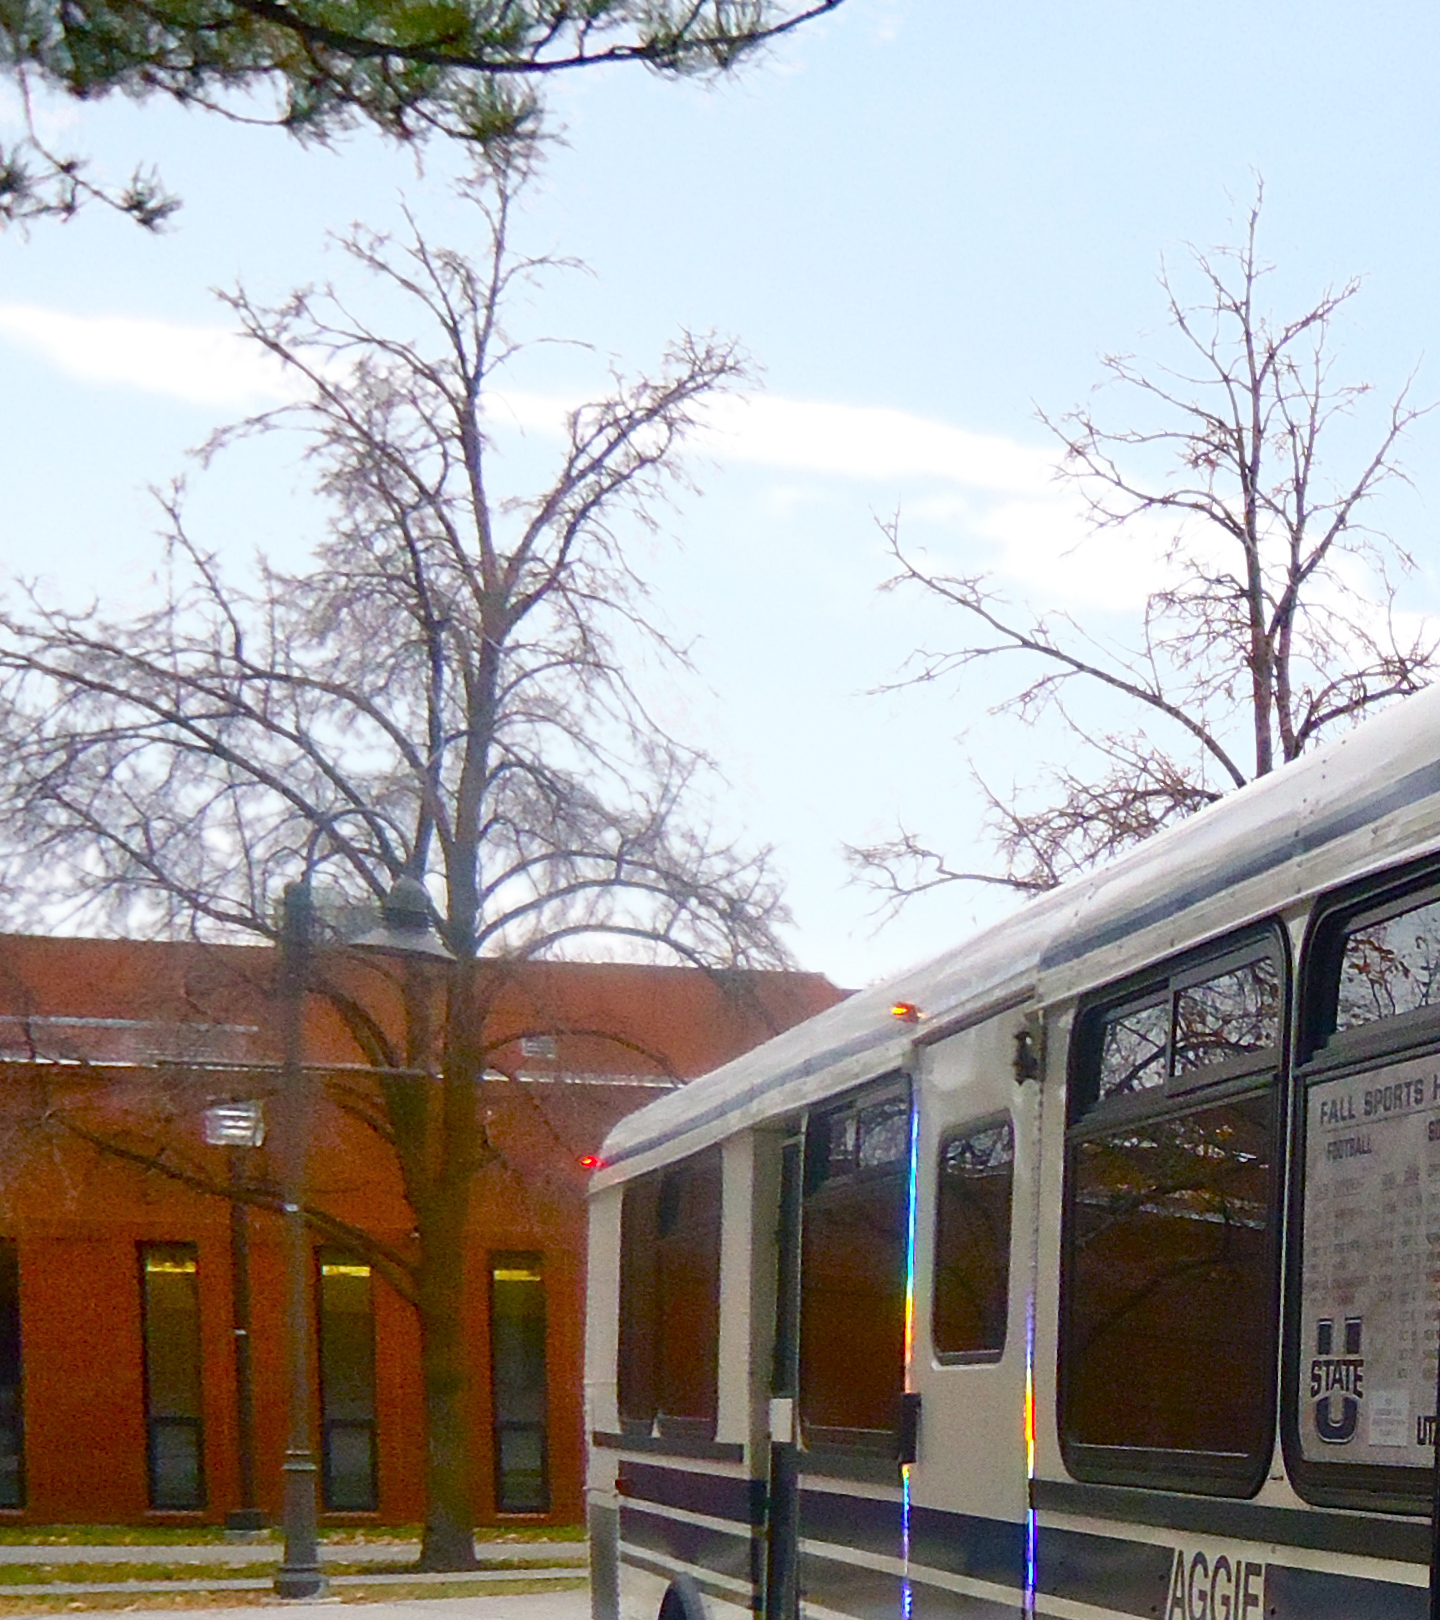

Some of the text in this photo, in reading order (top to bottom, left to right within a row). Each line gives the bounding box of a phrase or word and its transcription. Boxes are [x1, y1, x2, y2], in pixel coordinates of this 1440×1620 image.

[1319, 1095, 1356, 1125] FALL
[1363, 1079, 1424, 1118] SPORTS
[1326, 1134, 1373, 1162] FOOTBALL
[1310, 1359, 1365, 1398] STATE
